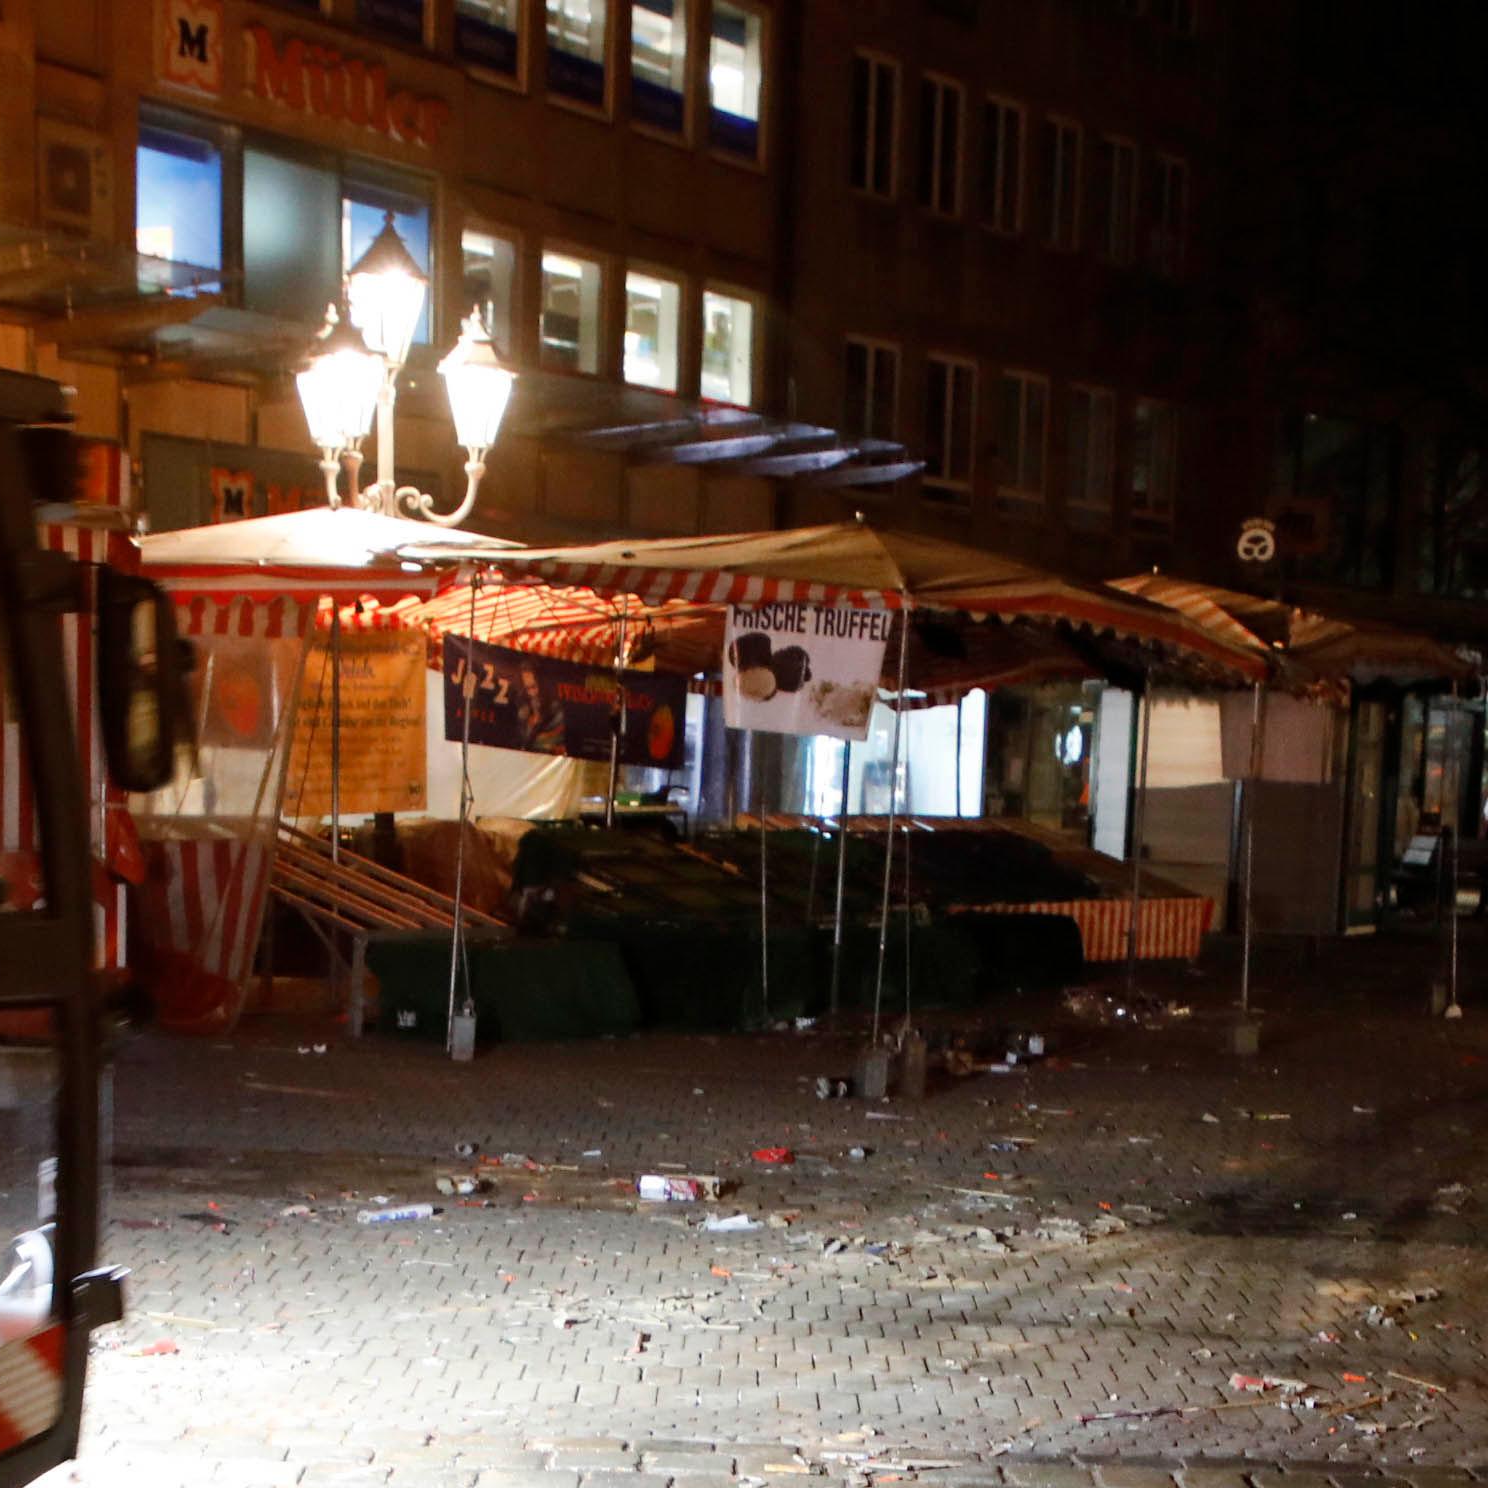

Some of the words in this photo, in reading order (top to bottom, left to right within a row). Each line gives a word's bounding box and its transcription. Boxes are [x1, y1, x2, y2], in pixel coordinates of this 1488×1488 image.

[178, 17, 208, 63] M
[244, 24, 449, 145] Müller
[733, 603, 808, 633] FRISCHE
